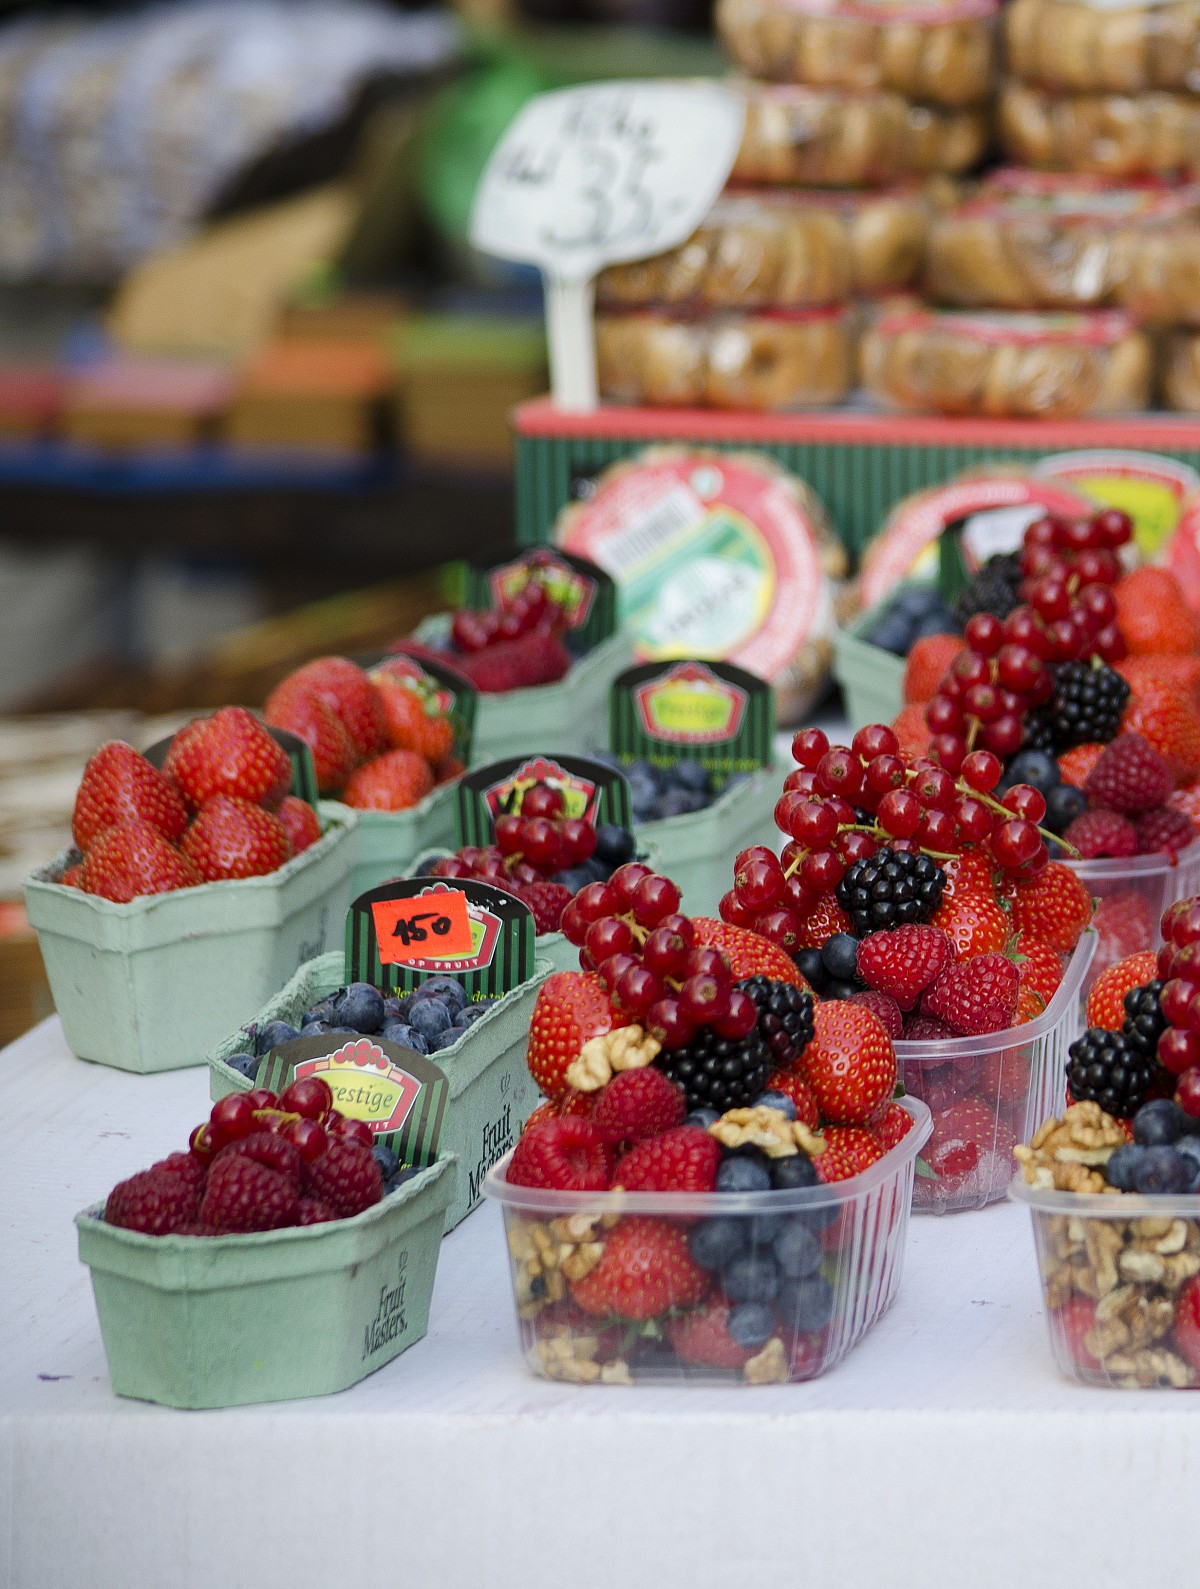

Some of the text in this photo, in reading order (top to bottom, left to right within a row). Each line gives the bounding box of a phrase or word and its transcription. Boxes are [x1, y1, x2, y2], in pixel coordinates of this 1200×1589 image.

[392, 912, 452, 946] 150
[435, 957, 479, 970] FRUIT
[330, 1084, 393, 1113] restige
[482, 1102, 511, 1164] Fruit
[378, 1276, 407, 1322] Fruit
